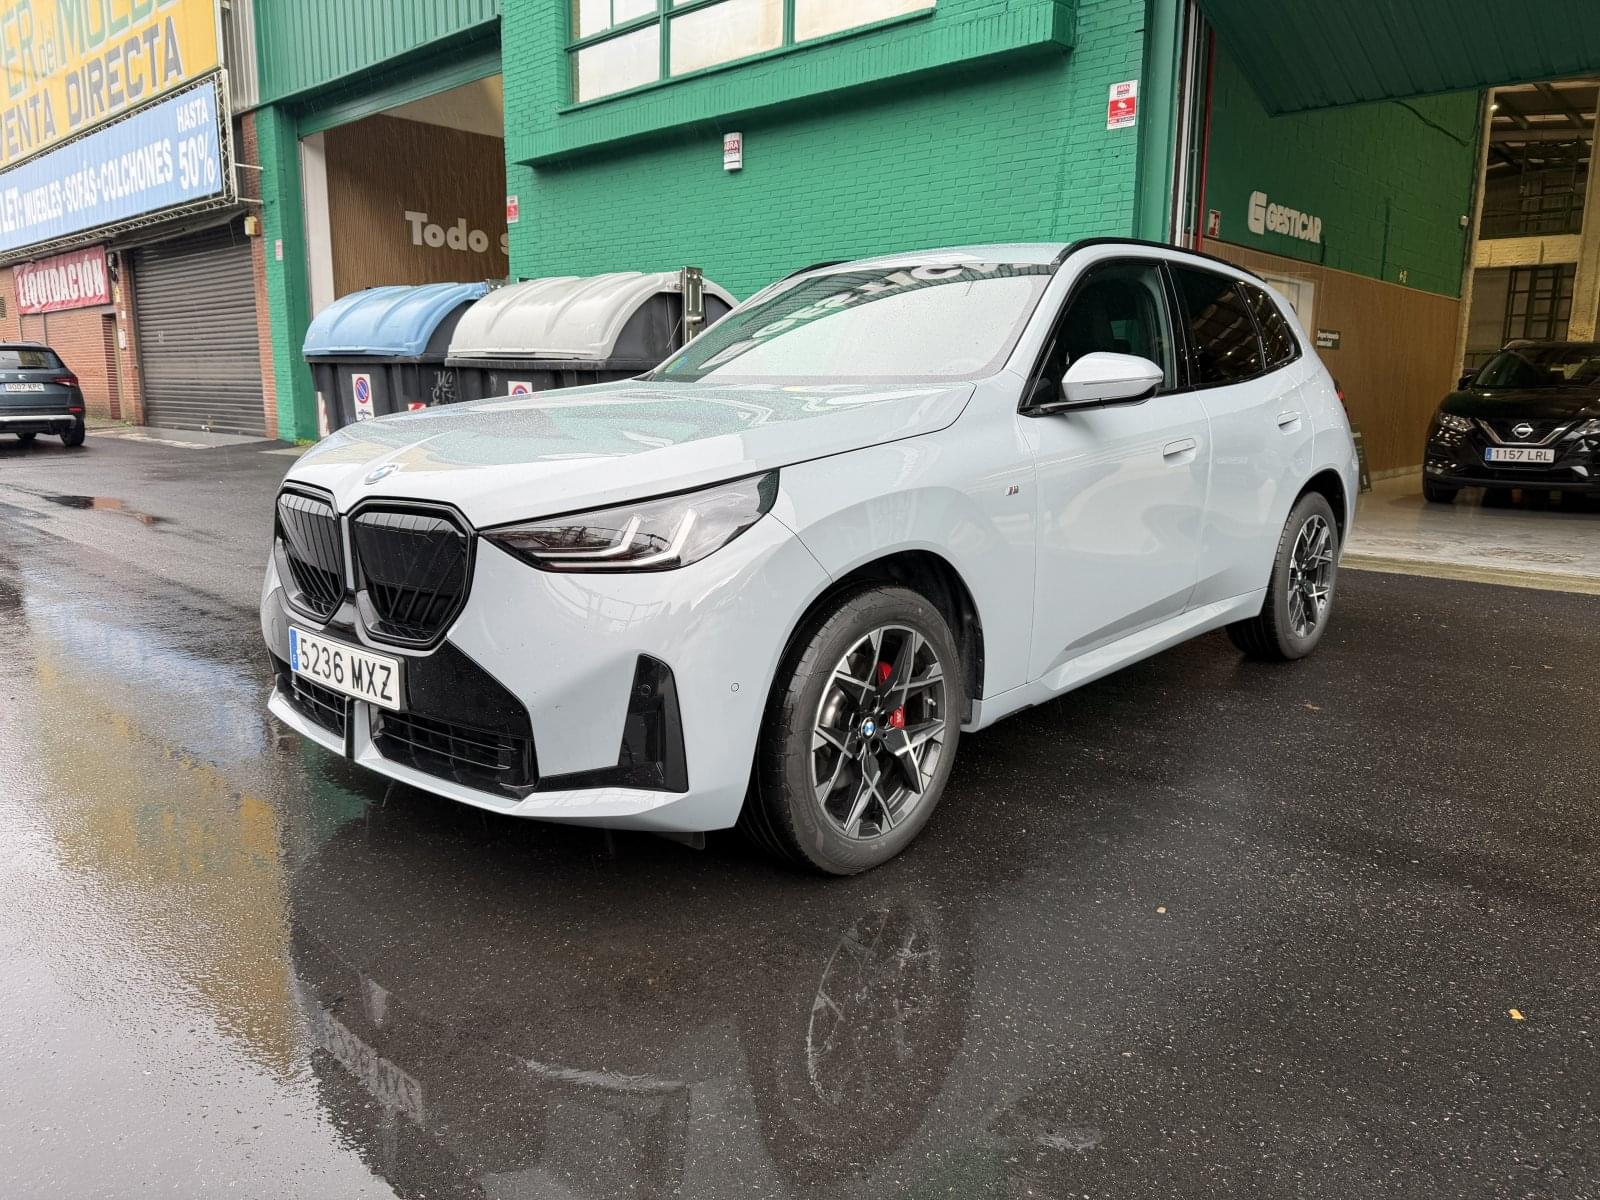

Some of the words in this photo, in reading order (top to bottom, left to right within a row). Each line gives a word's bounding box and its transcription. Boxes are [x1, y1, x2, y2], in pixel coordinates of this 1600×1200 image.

[0, 89, 56, 160] ENTA
[65, 15, 183, 128] DIRECTA
[176, 97, 209, 133] HASTA
[178, 132, 215, 190] 50%
[405, 210, 489, 253] Todo
[1266, 203, 1322, 243] GESTICAR
[18, 253, 105, 307] LIQUIDACIÓN
[1495, 449, 1524, 460] 1157
[1528, 450, 1552, 461] LRL
[300, 638, 344, 684] 5236
[351, 655, 393, 701] MXZ
